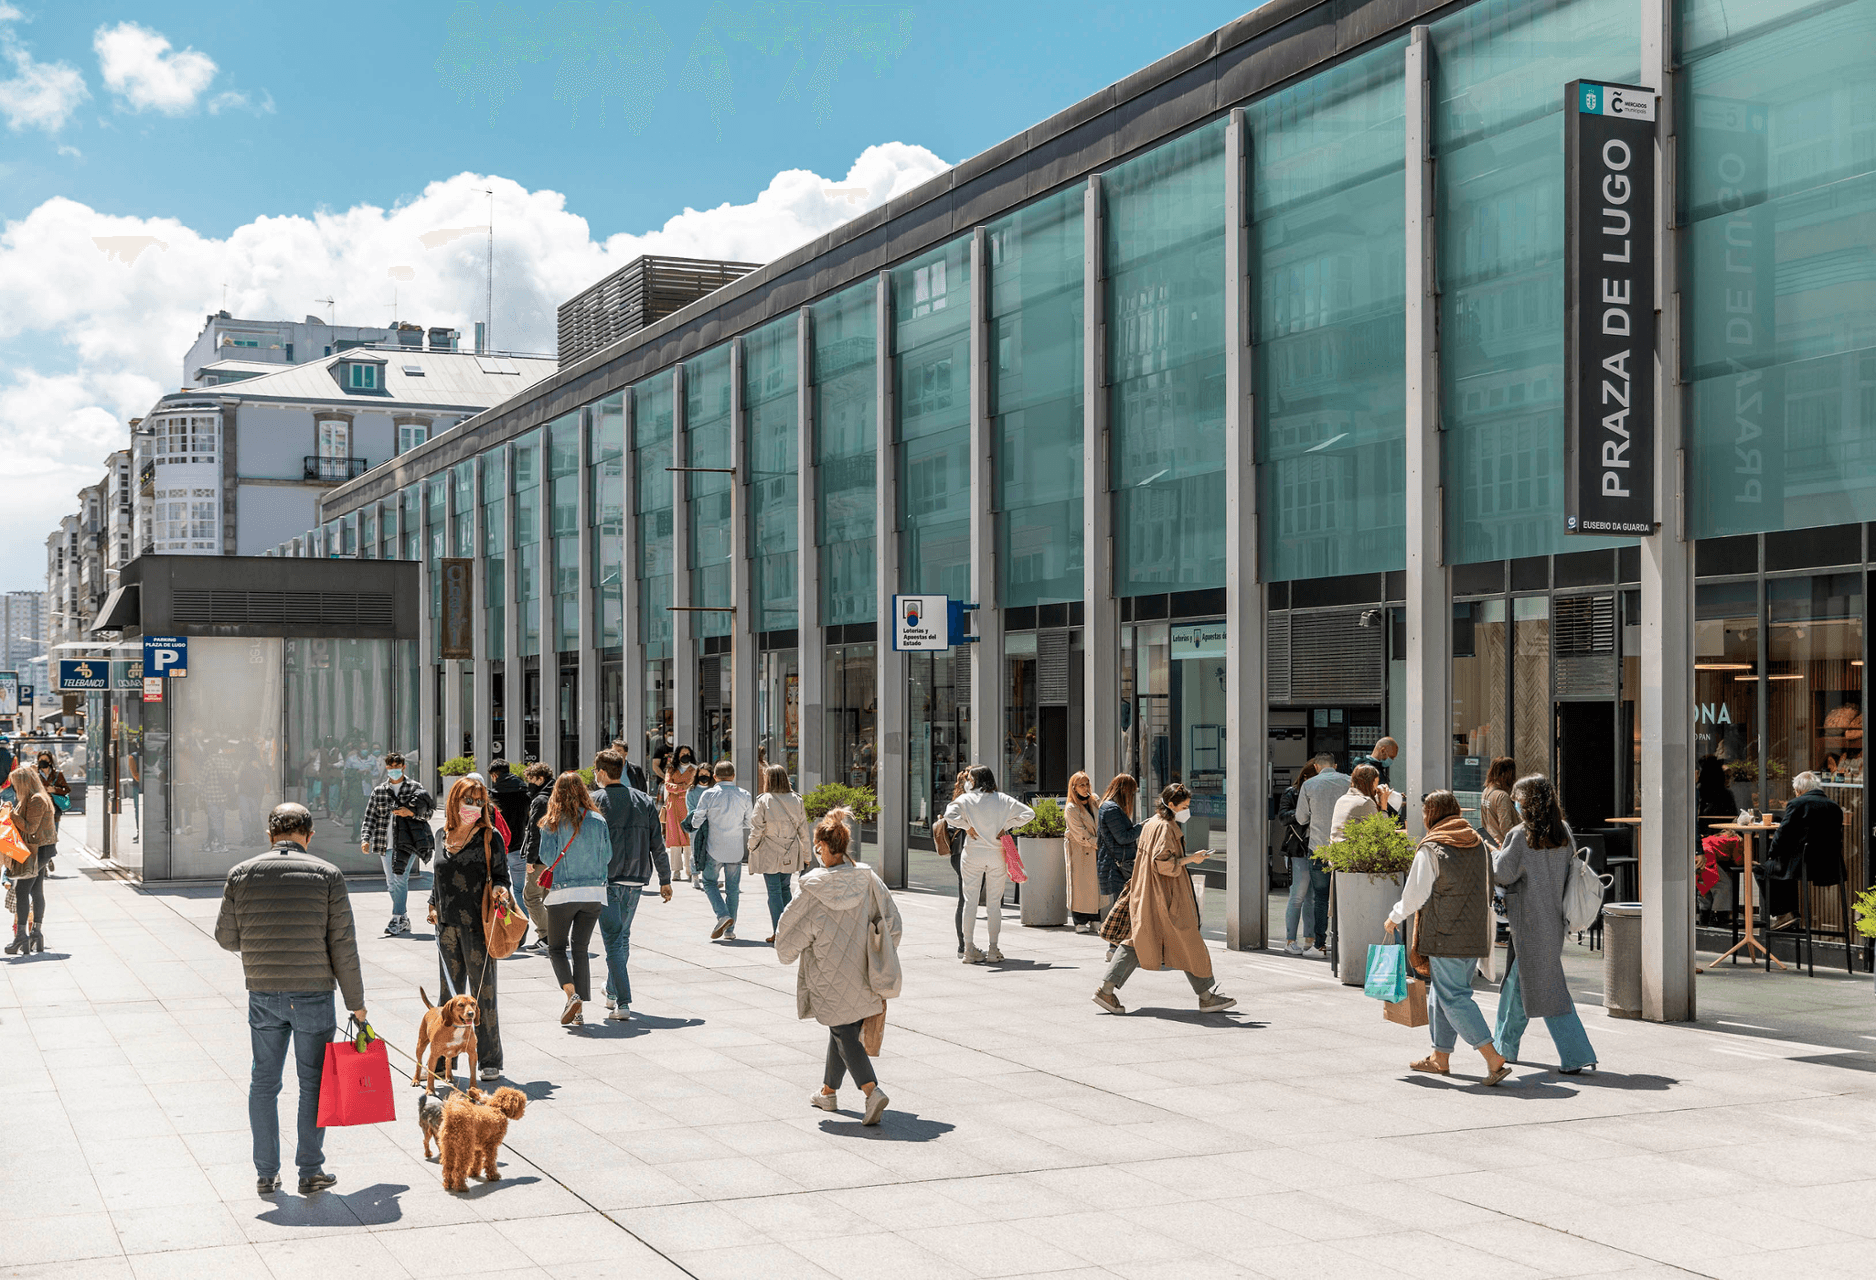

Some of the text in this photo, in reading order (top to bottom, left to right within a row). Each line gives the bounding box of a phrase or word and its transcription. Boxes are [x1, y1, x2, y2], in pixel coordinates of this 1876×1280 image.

[1624, 101, 1647, 109] MERCADOS
[1602, 139, 1632, 498] PRAZA DE LUGO
[1583, 521, 1611, 530] EUSEBIO
[1612, 523, 1621, 531] DA
[1622, 523, 1650, 532] GUARDA
[1202, 633, 1221, 642] Apuestas
[154, 649, 179, 671] P
[63, 679, 105, 688] TELEBANCO
[21, 686, 31, 698] P
[1699, 733, 1711, 741] PAN
